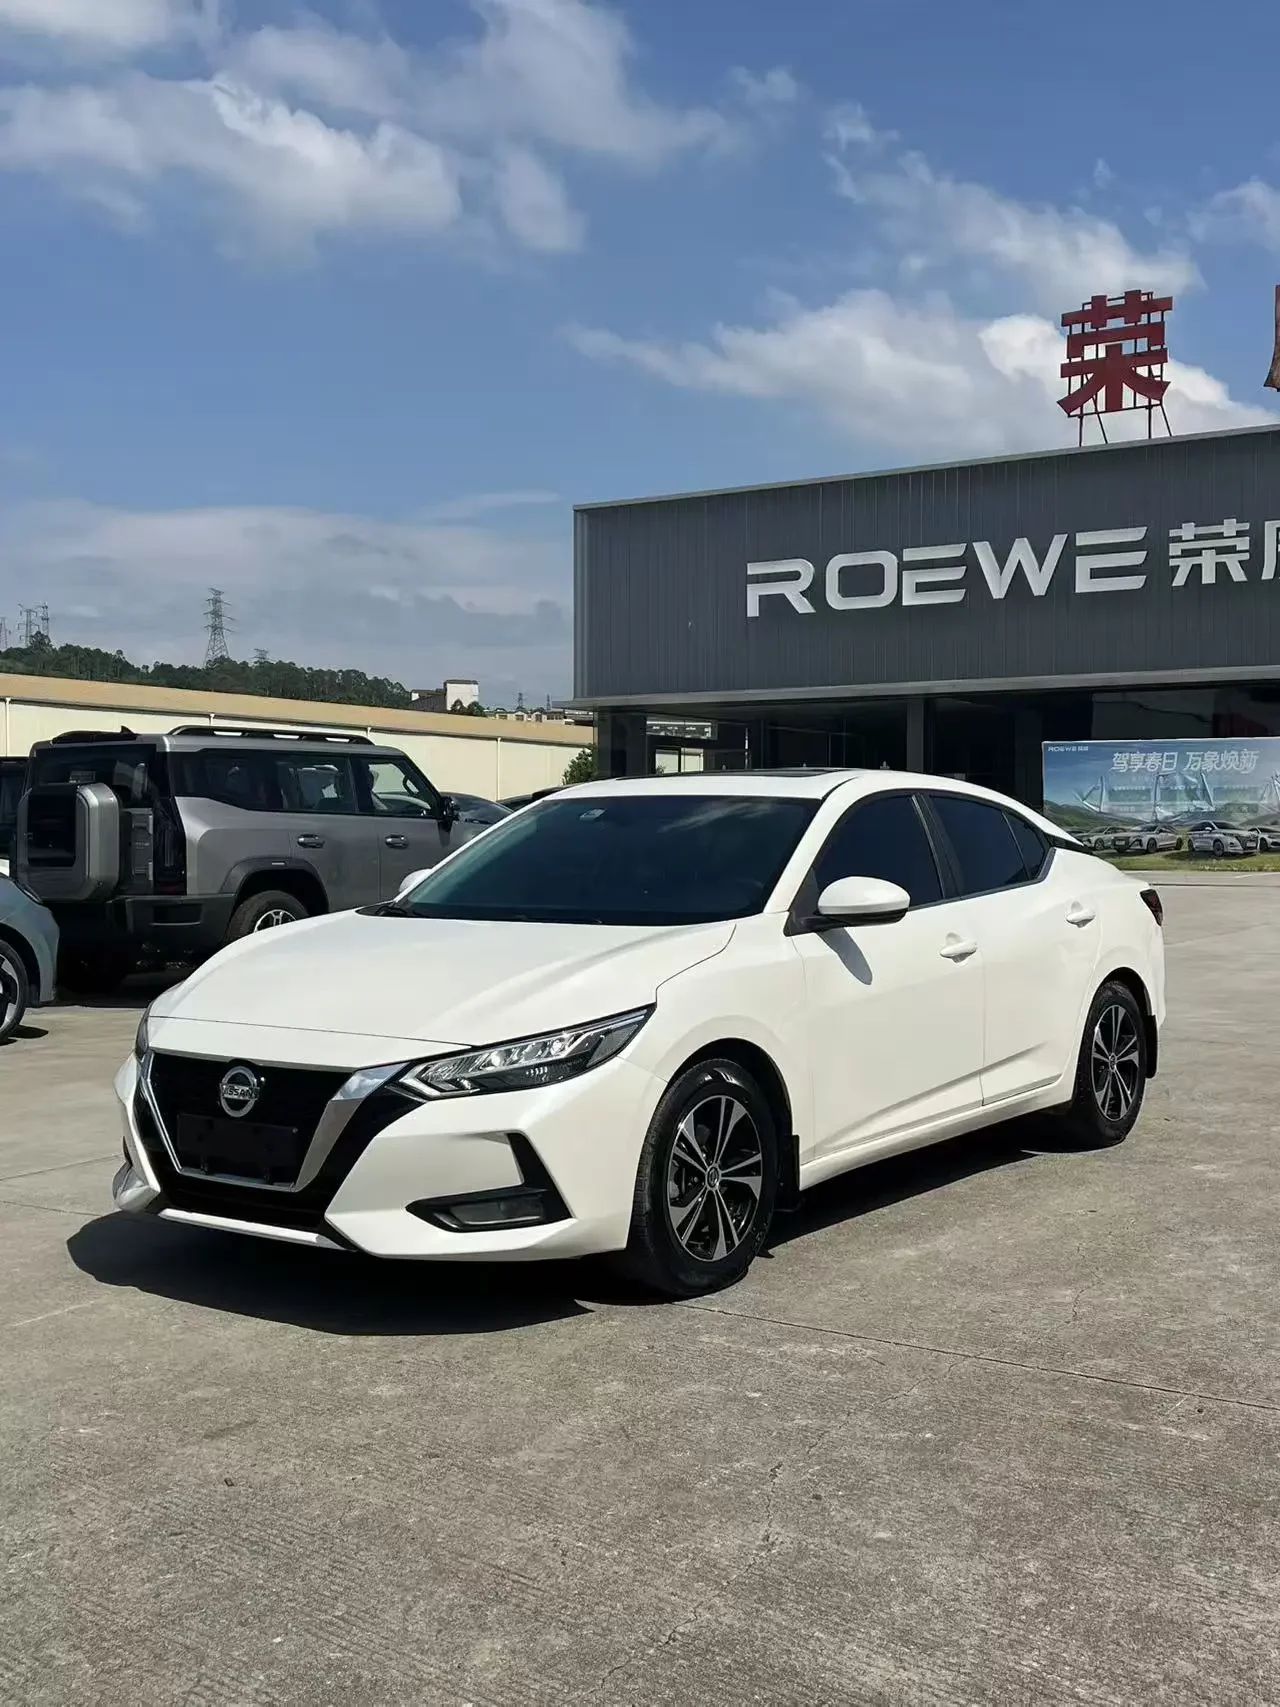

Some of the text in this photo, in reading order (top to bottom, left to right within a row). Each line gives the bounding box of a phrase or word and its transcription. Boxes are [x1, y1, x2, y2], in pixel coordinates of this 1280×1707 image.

[1057, 289, 1173, 416] 荣
[746, 518, 1280, 618] ROEWE 荣
[1111, 750, 1260, 773] 驾享春日 万象焕新
